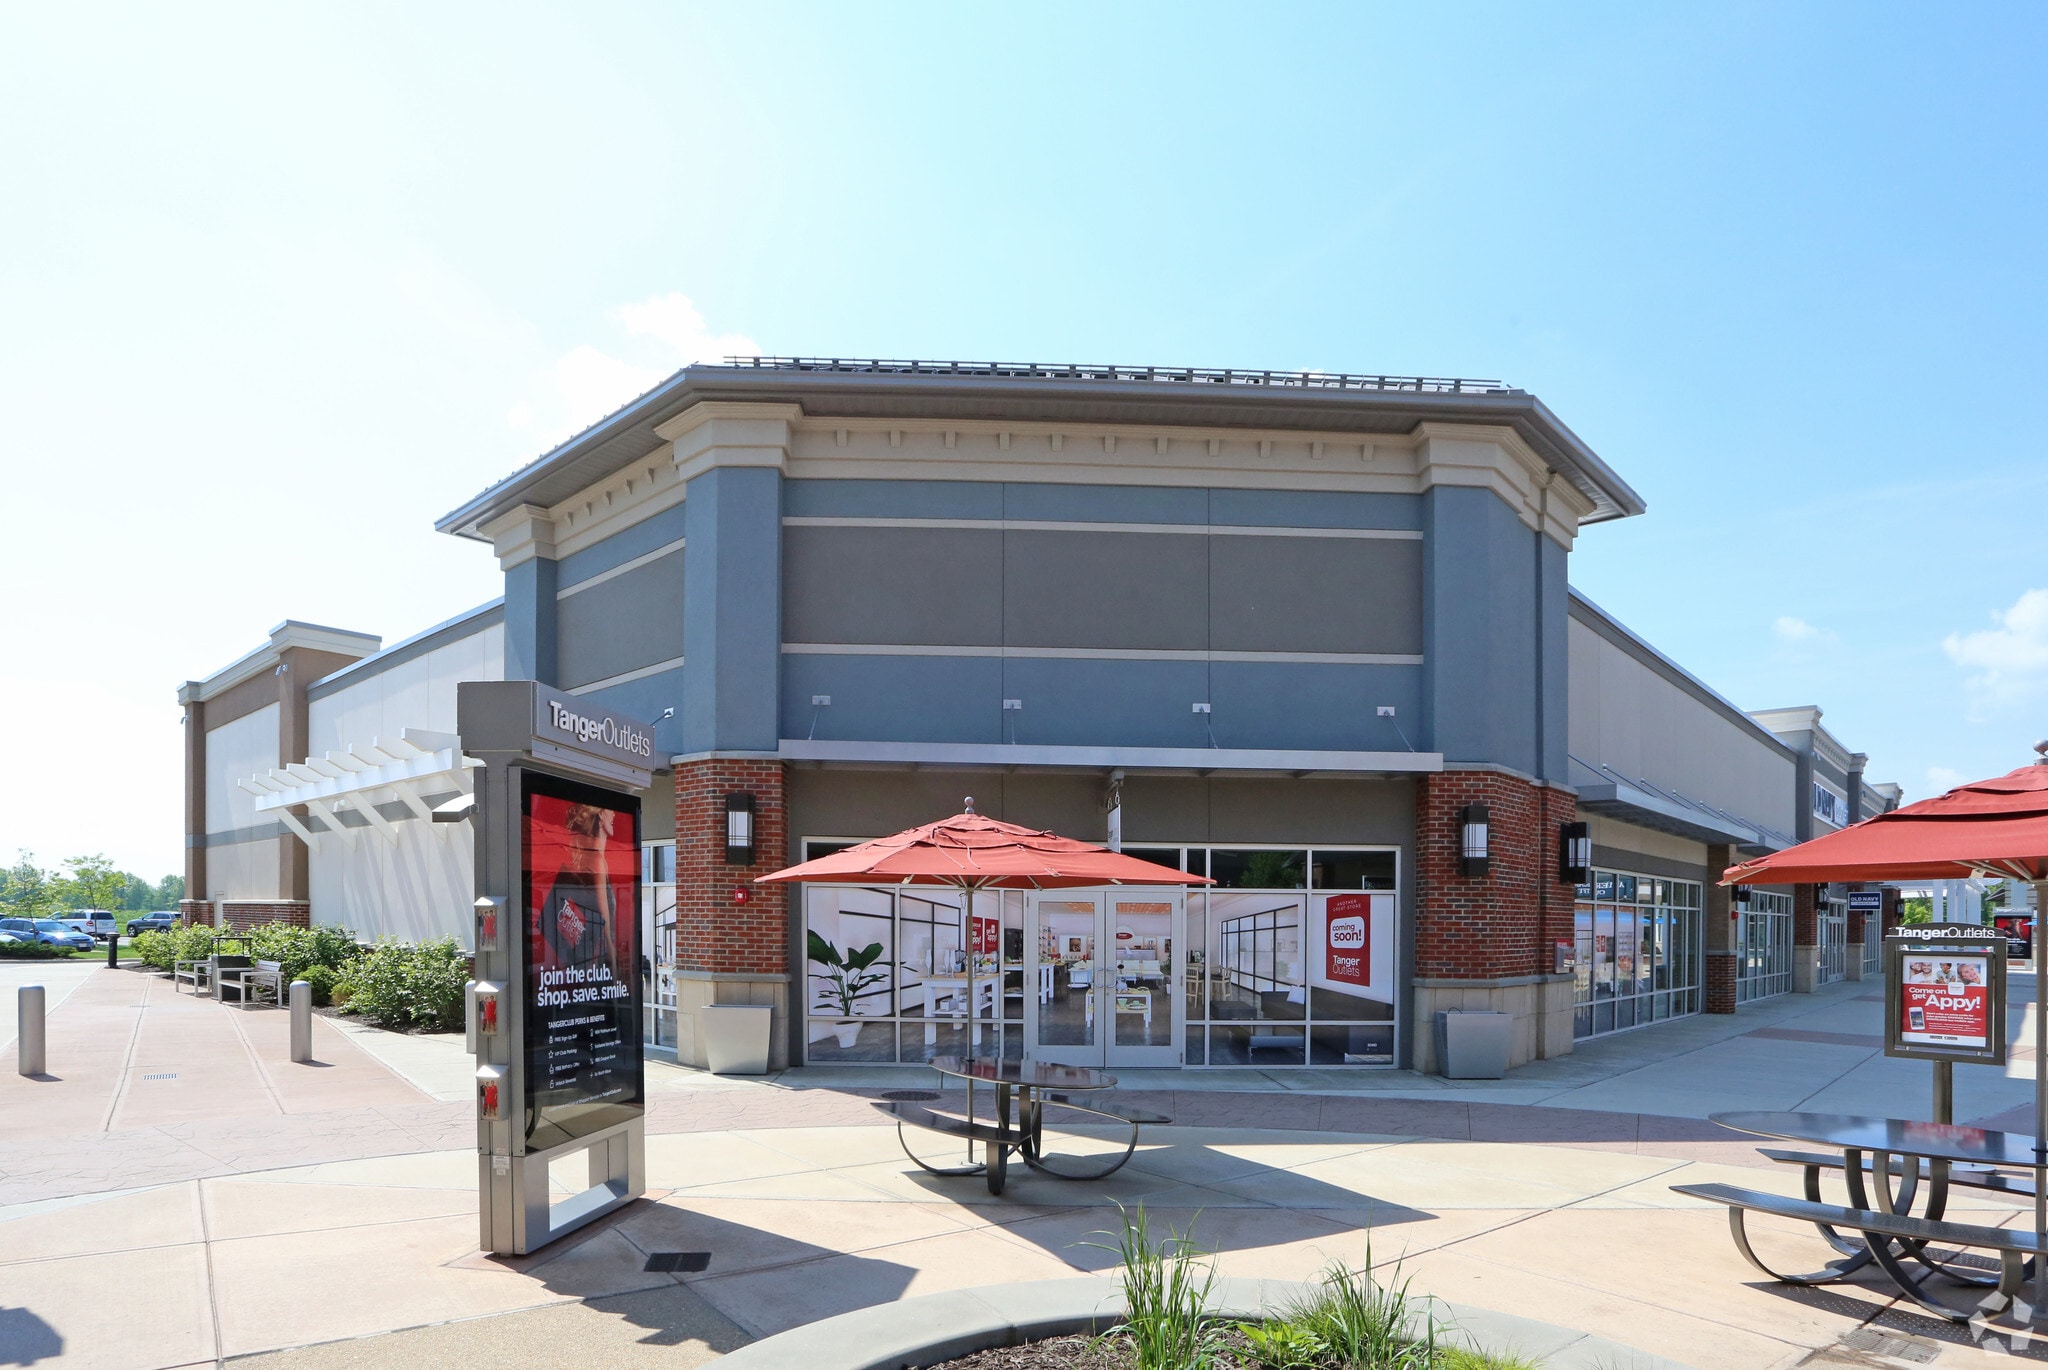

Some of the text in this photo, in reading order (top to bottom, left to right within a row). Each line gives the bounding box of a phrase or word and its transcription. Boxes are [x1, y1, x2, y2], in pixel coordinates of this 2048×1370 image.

[548, 700, 650, 757] TangerOutlets
[562, 899, 587, 934] Tanger
[1332, 923, 1355, 932] coming
[1895, 926, 1996, 941] TangerOutlets
[1334, 929, 1362, 942] soon!
[1332, 955, 1360, 968] Tanger
[539, 963, 613, 991] join the club.
[1332, 964, 1360, 977] Outlets
[537, 980, 630, 1009] shop. save. smile.
[1908, 986, 1934, 994] Come
[1924, 994, 1981, 1012] Appy!
